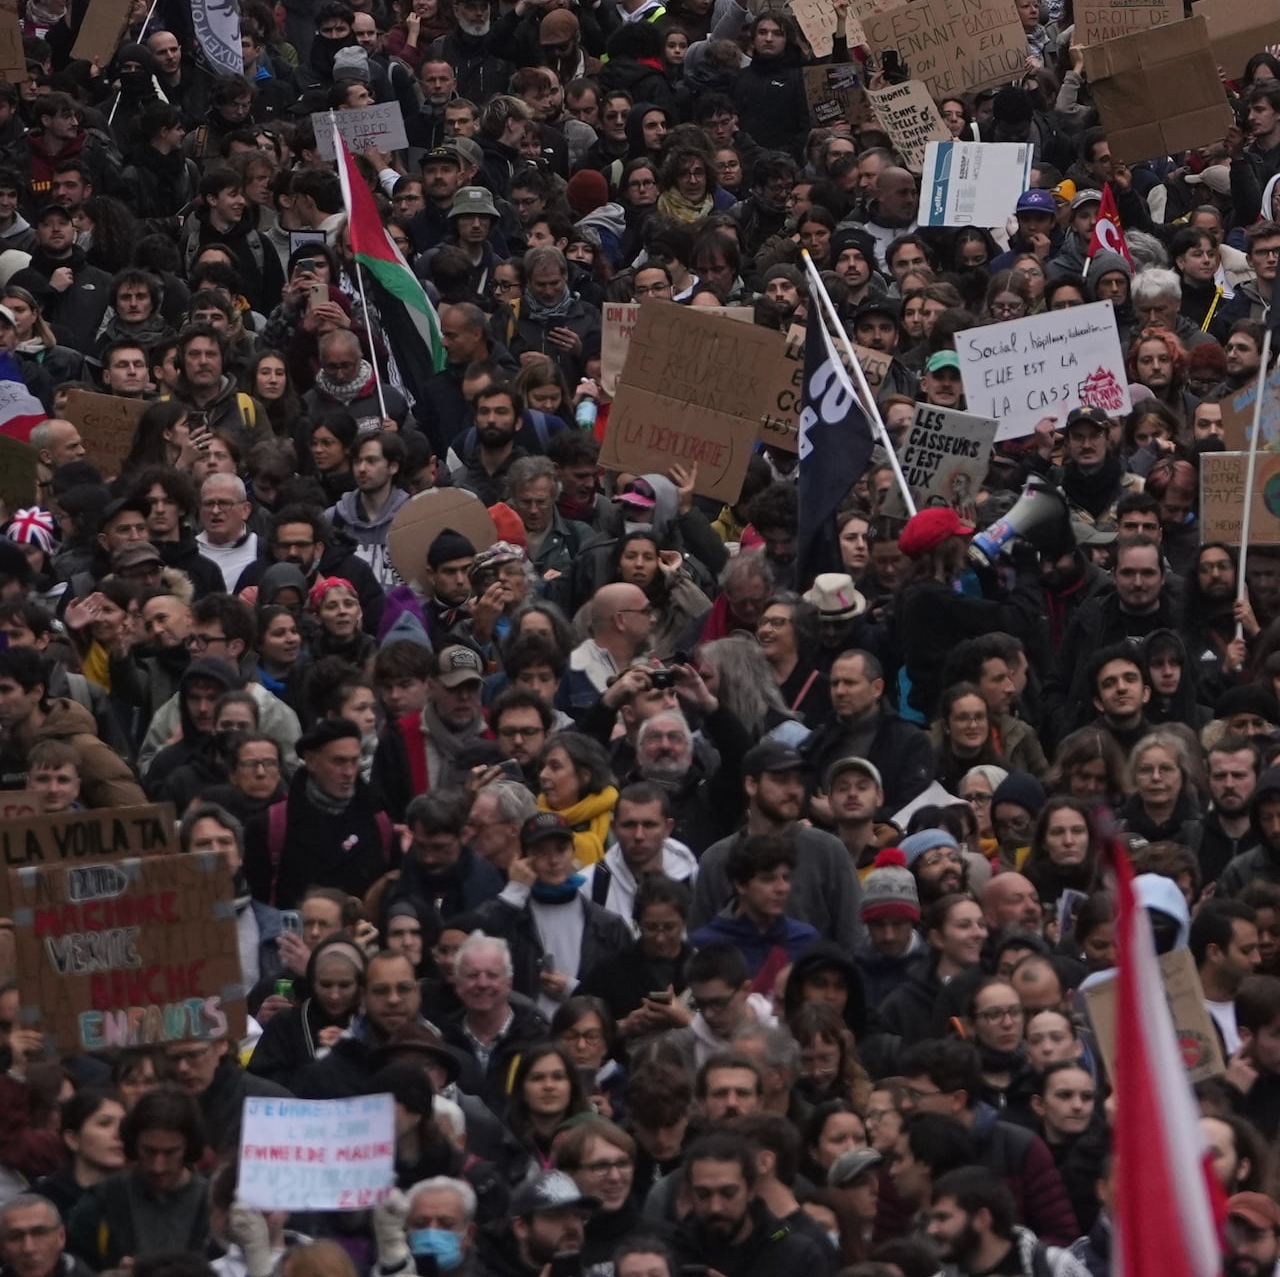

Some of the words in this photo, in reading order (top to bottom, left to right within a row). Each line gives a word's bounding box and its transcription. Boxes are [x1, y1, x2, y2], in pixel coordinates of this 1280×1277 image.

[1085, 11, 1139, 25] DROIT
[1150, 10, 1169, 24] DE
[978, 34, 1005, 50] EU
[1023, 360, 1046, 375] EST
[915, 408, 947, 432] LES
[992, 396, 1011, 420] LA
[909, 430, 981, 460] CASSEURS
[904, 446, 945, 471] C'EST
[3, 829, 45, 864] LA
[133, 817, 169, 852] TA
